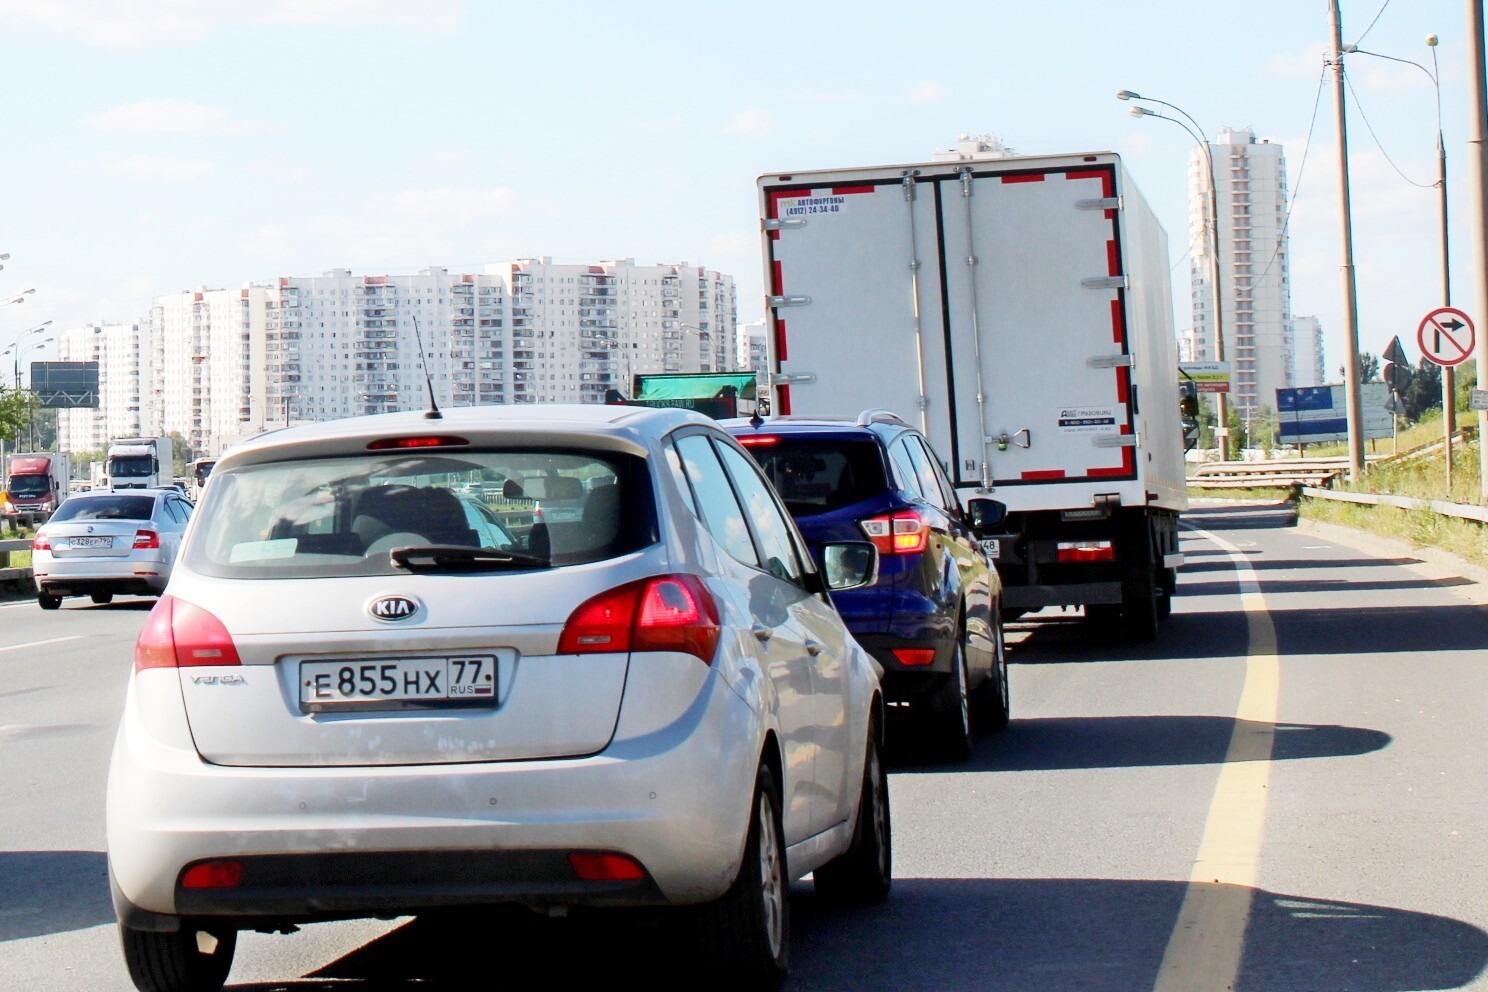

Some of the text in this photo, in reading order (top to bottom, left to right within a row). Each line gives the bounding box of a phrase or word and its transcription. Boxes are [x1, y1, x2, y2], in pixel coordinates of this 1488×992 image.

[798, 197, 845, 207] АВТОФУРГОНЫ
[786, 207, 807, 216] (4912)
[983, 540, 995, 550] 48
[376, 600, 410, 615] KIA
[452, 660, 483, 684] 77
[450, 685, 474, 695] RUS
